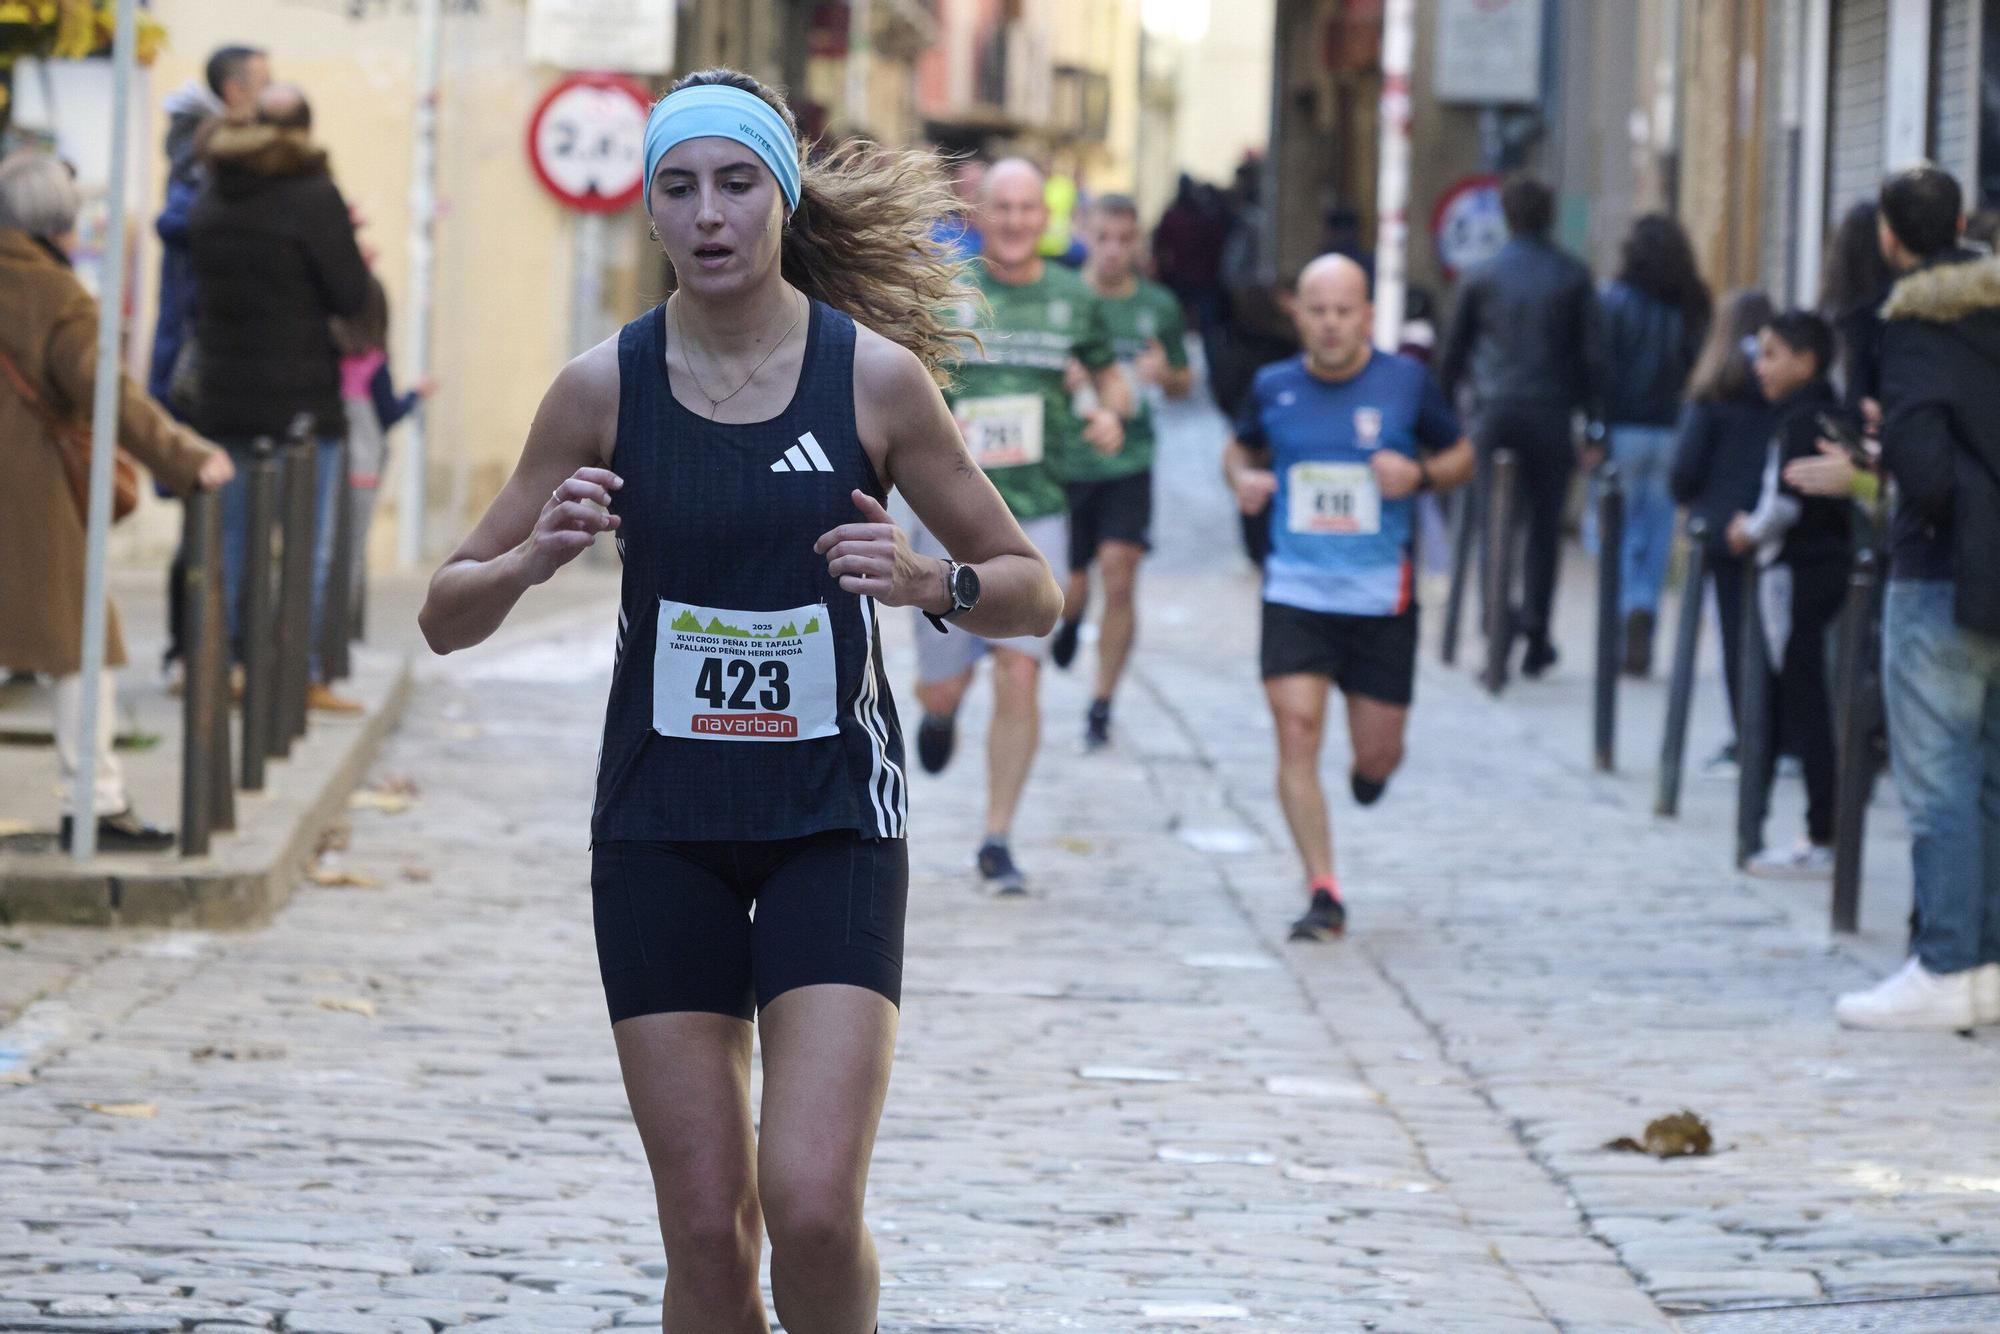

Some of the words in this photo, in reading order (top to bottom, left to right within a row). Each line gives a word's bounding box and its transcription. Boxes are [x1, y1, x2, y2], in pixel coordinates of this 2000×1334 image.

[740, 123, 771, 152] VELITES
[676, 634, 694, 643] XLVI
[695, 636, 720, 645] CROSS
[722, 638, 748, 648] PEÑAS
[766, 638, 803, 648] TAFALLA
[670, 642, 717, 654] TAFALLAKO
[718, 647, 746, 656] PEÑEN
[775, 647, 803, 657] KROSA
[695, 657, 790, 711] 423
[697, 717, 792, 733] navarban
